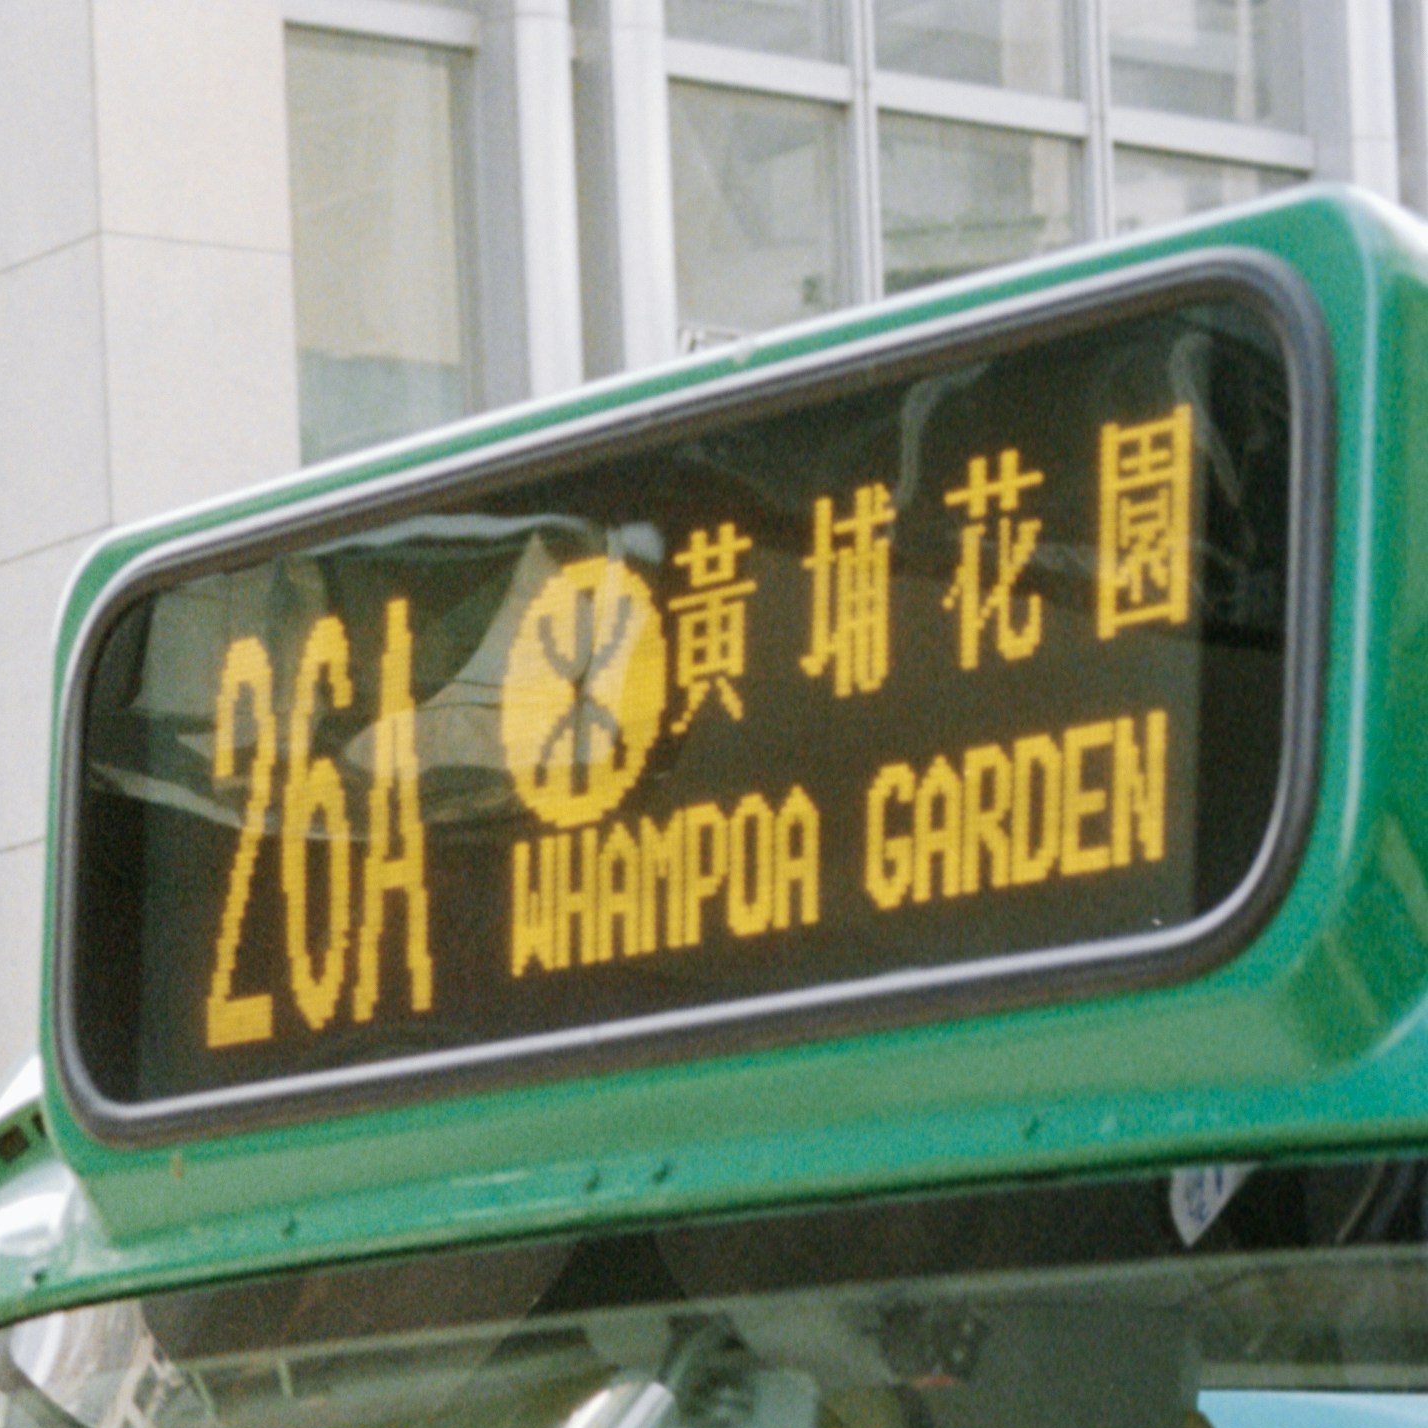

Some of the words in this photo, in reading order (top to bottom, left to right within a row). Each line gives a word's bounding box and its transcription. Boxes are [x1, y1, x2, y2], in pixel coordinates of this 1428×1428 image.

[206, 599, 432, 1049] 26A
[511, 785, 820, 977] WHAMPOA
[865, 709, 1167, 910] GARDEN
